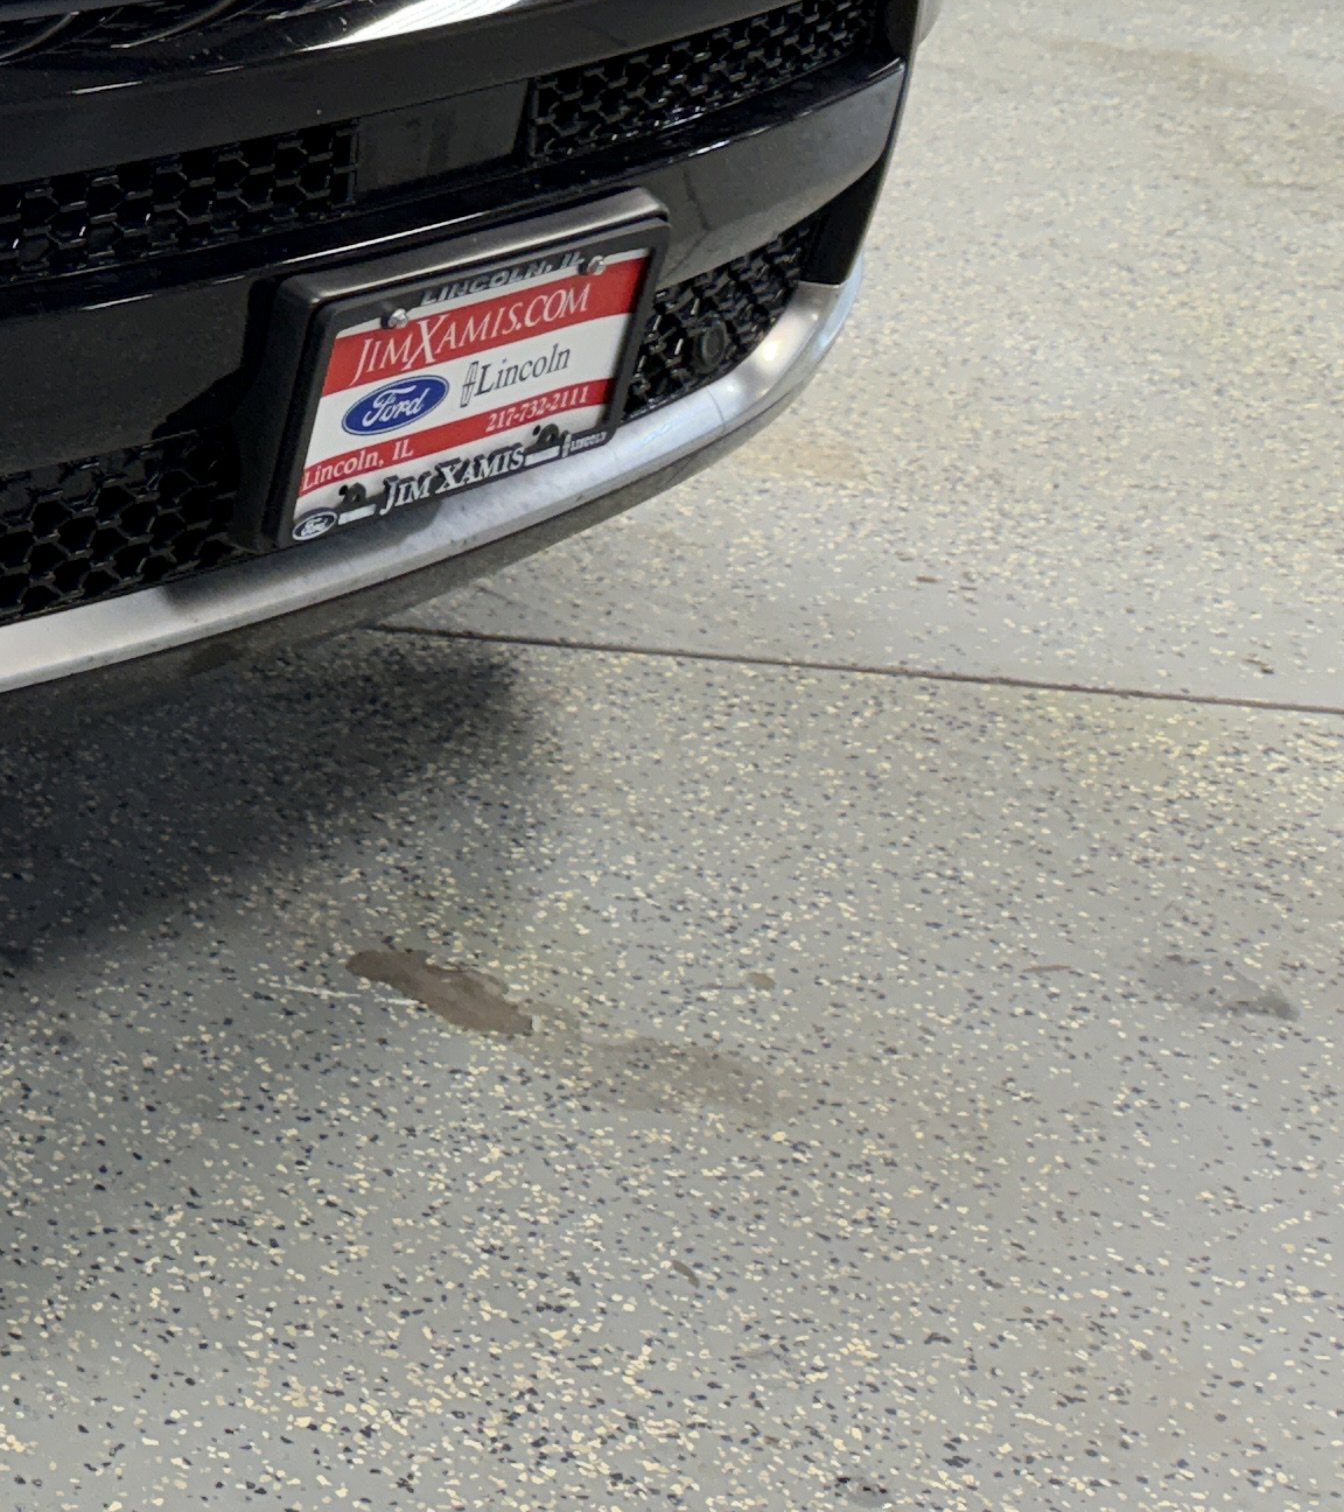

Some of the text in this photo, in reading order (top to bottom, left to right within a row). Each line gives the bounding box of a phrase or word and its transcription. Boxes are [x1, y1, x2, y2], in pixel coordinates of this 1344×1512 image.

[350, 283, 592, 386] JIMXAMIS.COM
[473, 343, 571, 397] Lincoln
[361, 384, 425, 426] Ford
[485, 385, 590, 433] 217-732-2111
[302, 439, 414, 491] Lincoln, IL
